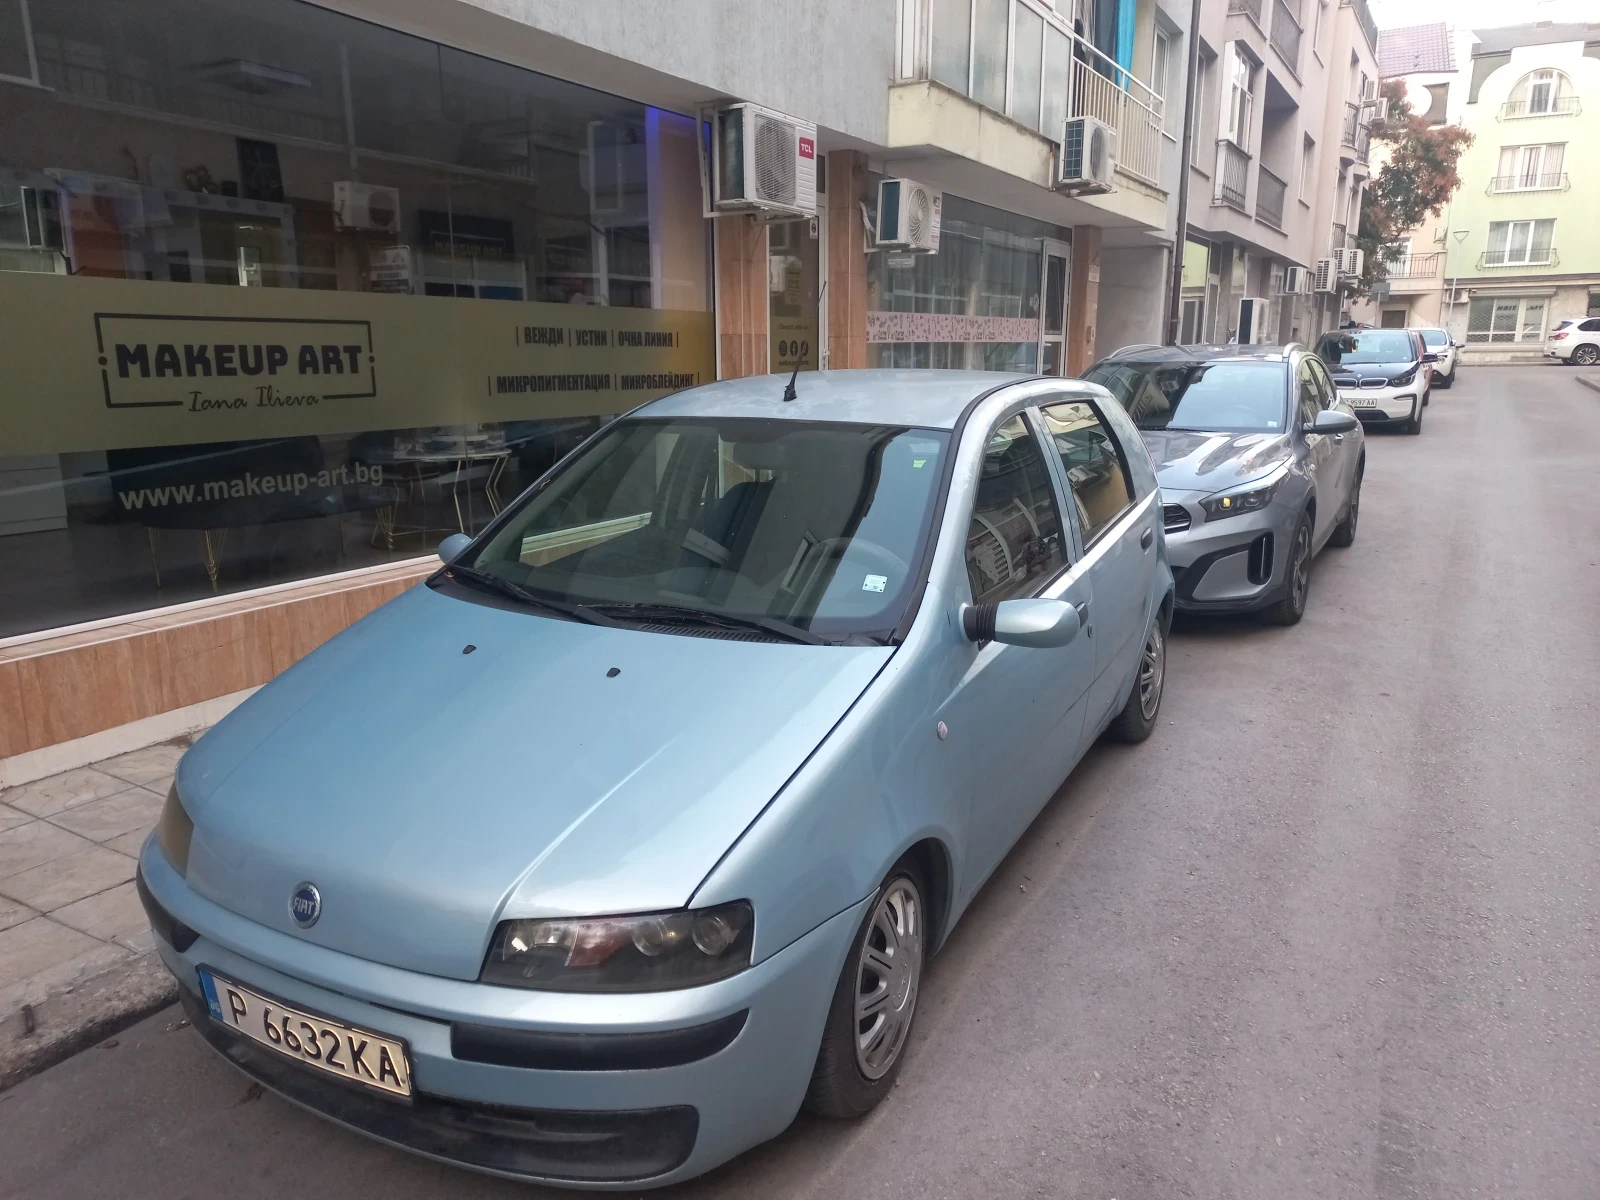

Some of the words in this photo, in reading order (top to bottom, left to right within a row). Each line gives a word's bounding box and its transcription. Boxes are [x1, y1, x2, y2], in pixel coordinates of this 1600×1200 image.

[800, 143, 812, 154] TCL
[523, 326, 564, 346] ВЕЖДИ
[575, 330, 607, 346] УСТНИ
[618, 331, 643, 347] ОЧНА
[644, 332, 673, 347] ЛИНИЯ
[115, 343, 288, 378] MAKEUP
[298, 344, 362, 375] ART
[496, 373, 611, 393] МИКРОПИГМЕНТАЦИЯ
[621, 371, 694, 390] МИКРОБЛЕЙДИНГ
[188, 390, 248, 412] Iana
[256, 385, 319, 407] Ilieva
[119, 462, 384, 510] www.makeup-art.bg
[293, 897, 315, 915] FIAT
[227, 988, 248, 1024] P
